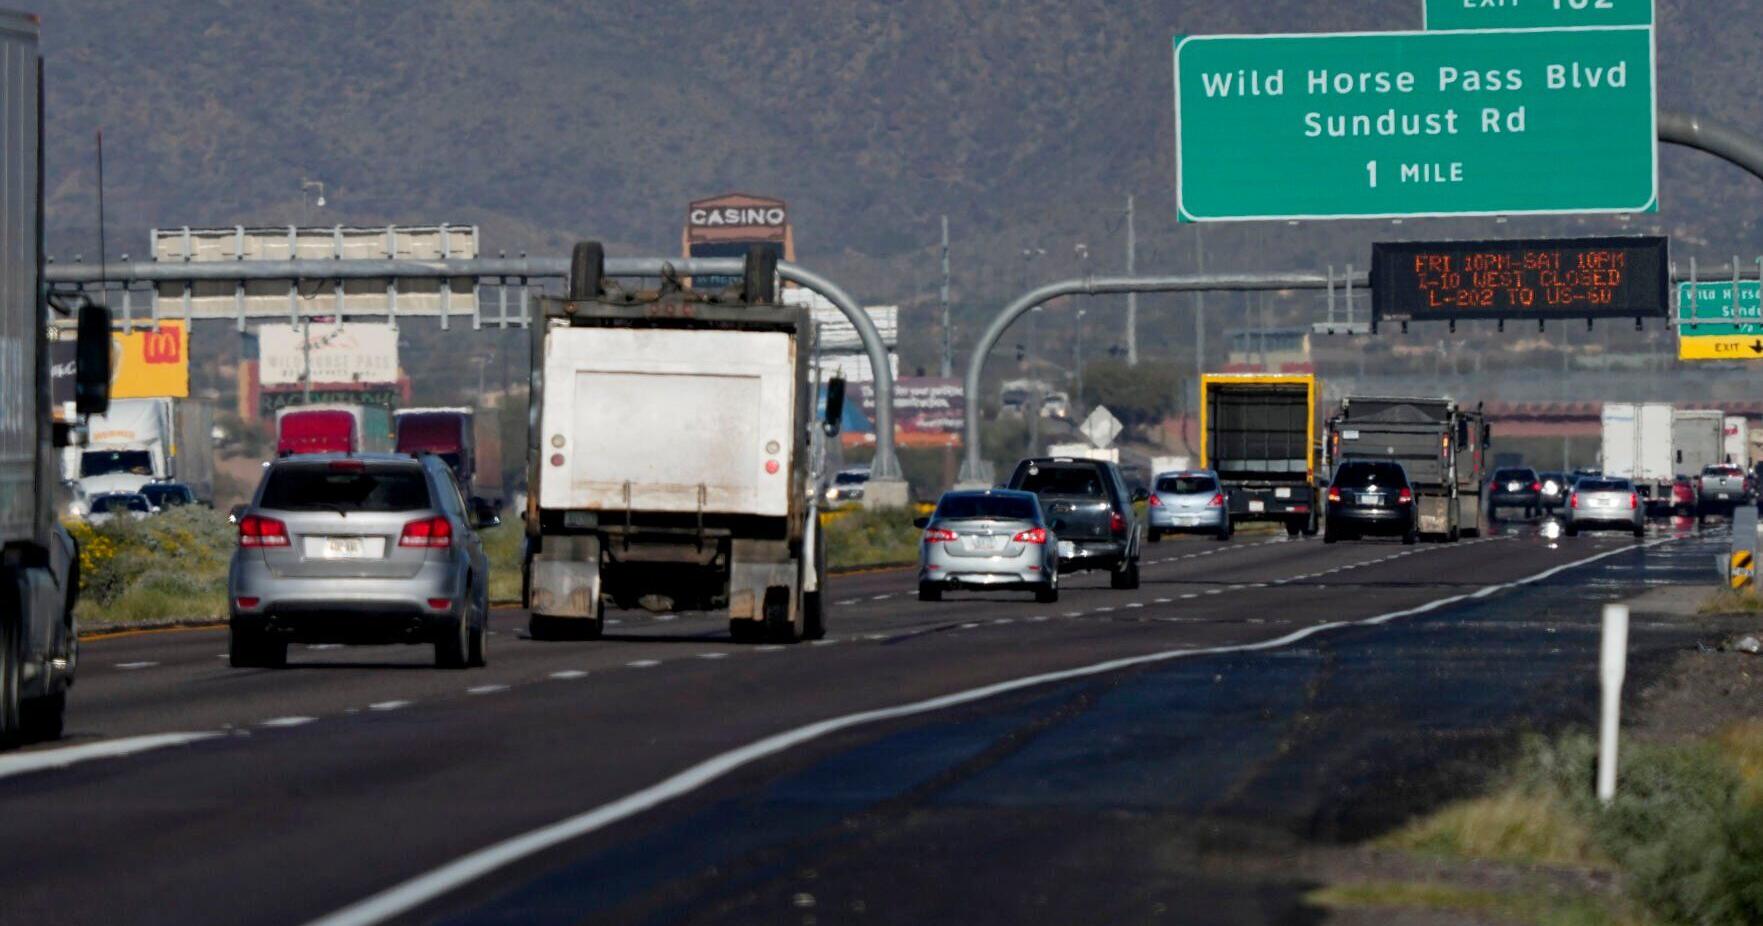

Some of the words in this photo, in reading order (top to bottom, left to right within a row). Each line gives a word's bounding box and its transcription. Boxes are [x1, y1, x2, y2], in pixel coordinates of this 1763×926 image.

[1201, 68, 1284, 98] Wild
[1307, 69, 1415, 95] Horse
[1438, 66, 1522, 92] Pass
[1546, 61, 1627, 90] Blvd
[1304, 108, 1459, 138] Sundust
[1481, 106, 1526, 134] Rd
[1366, 160, 1377, 188] 1
[1401, 162, 1463, 183] MILE
[690, 208, 785, 226] CASINO
[1414, 254, 1451, 273] FRI
[1576, 251, 1625, 271] 10PM
[1473, 270, 1524, 288] WEST
[1540, 268, 1620, 288] CLOSED
[1507, 288, 1535, 306] TO
[1714, 342, 1740, 352] EXIT
